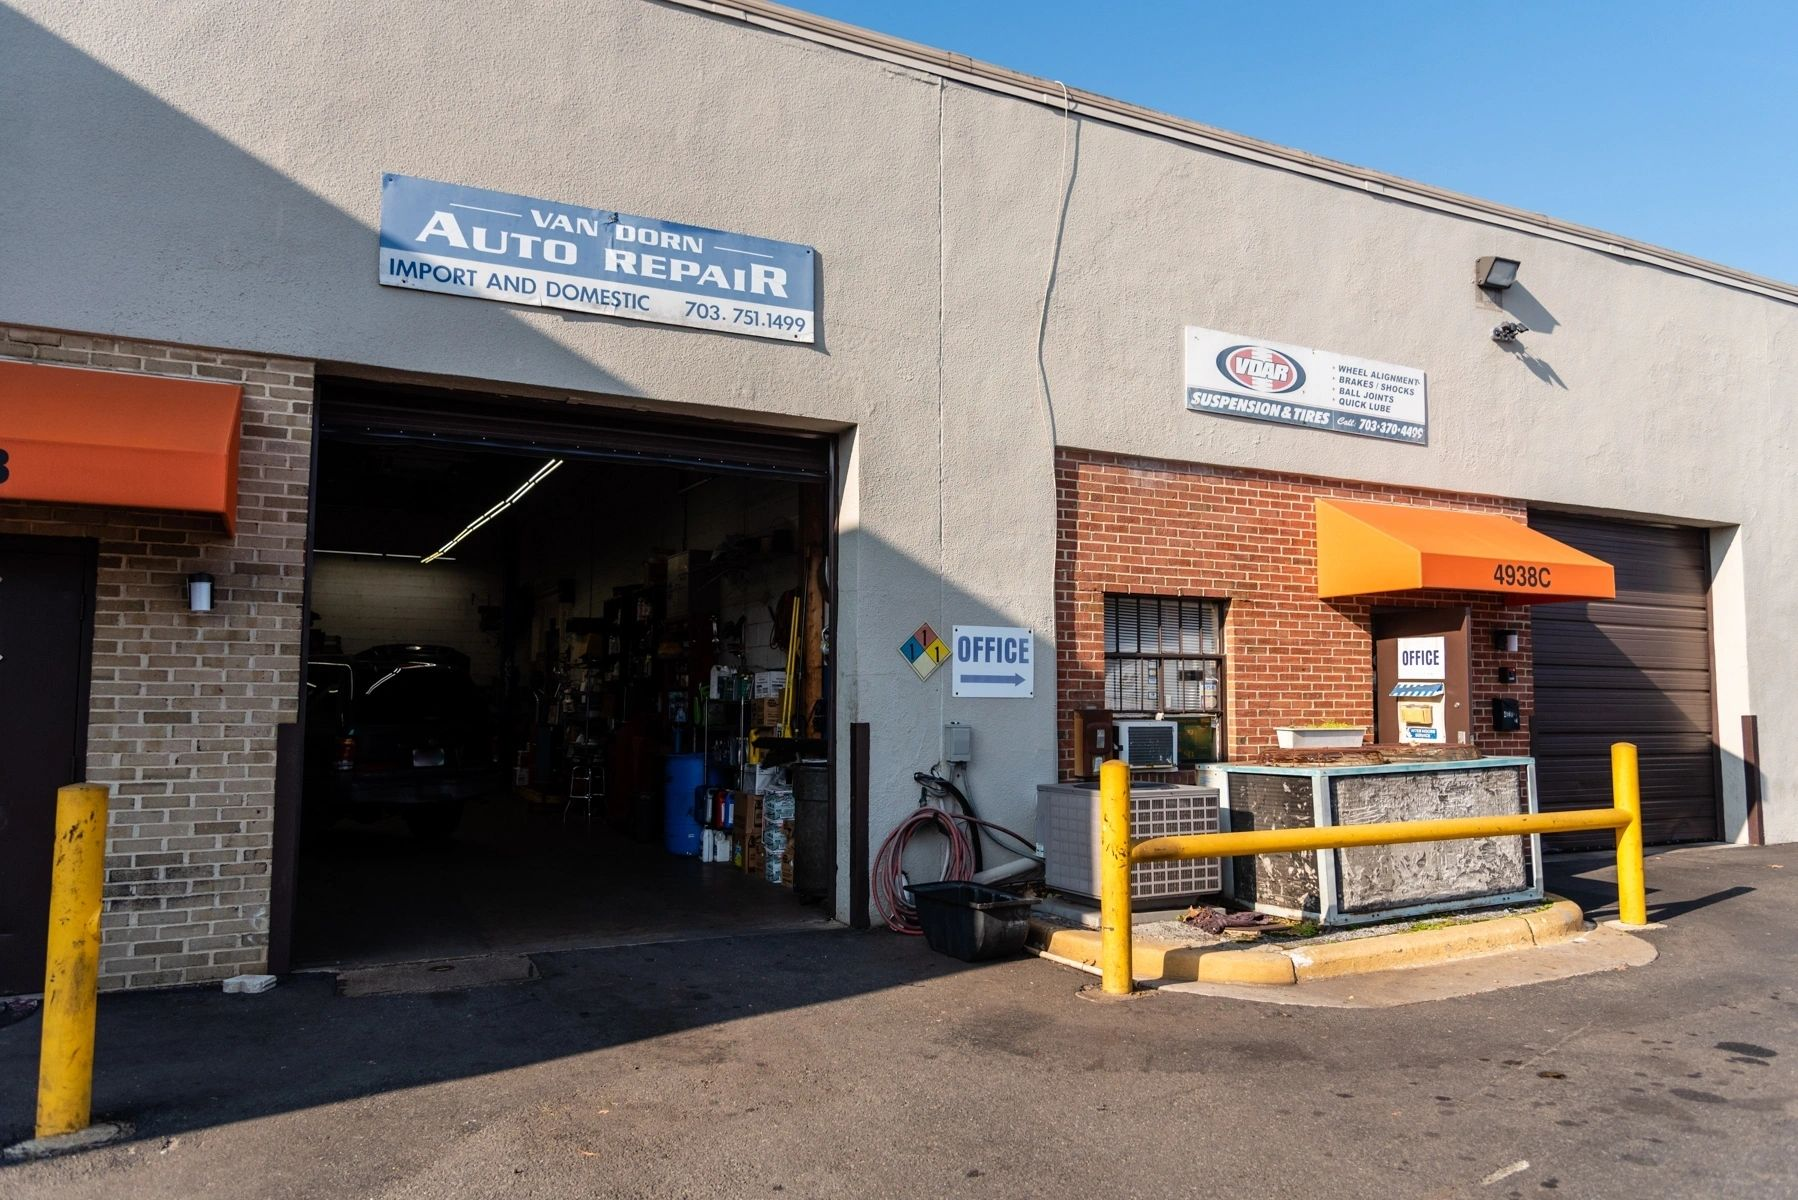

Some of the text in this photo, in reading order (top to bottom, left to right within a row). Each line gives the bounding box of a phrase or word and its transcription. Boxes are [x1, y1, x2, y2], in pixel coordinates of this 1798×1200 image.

[530, 209, 703, 254] VAN DORN
[415, 210, 788, 298] AUTO REPAIR
[389, 257, 650, 312] IMPORT AND DOMESTIC
[1235, 356, 1290, 382] VDAR
[1338, 364, 1419, 386] WHEEL ALIGNMENT
[1338, 376, 1374, 389] BRAKES
[1380, 383, 1415, 396] SHOCKS
[1338, 387, 1394, 403] BALL JOINTS
[1190, 391, 1331, 425] SUSPENSION & TIRES
[1338, 397, 1391, 413] QUICK LUBE
[1493, 564, 1551, 588] 4938C
[922, 629, 927, 646] 1
[909, 643, 915, 660] 1
[934, 646, 940, 662] 1
[957, 635, 1030, 664] OFFICE
[1402, 649, 1440, 666] OFFICE
